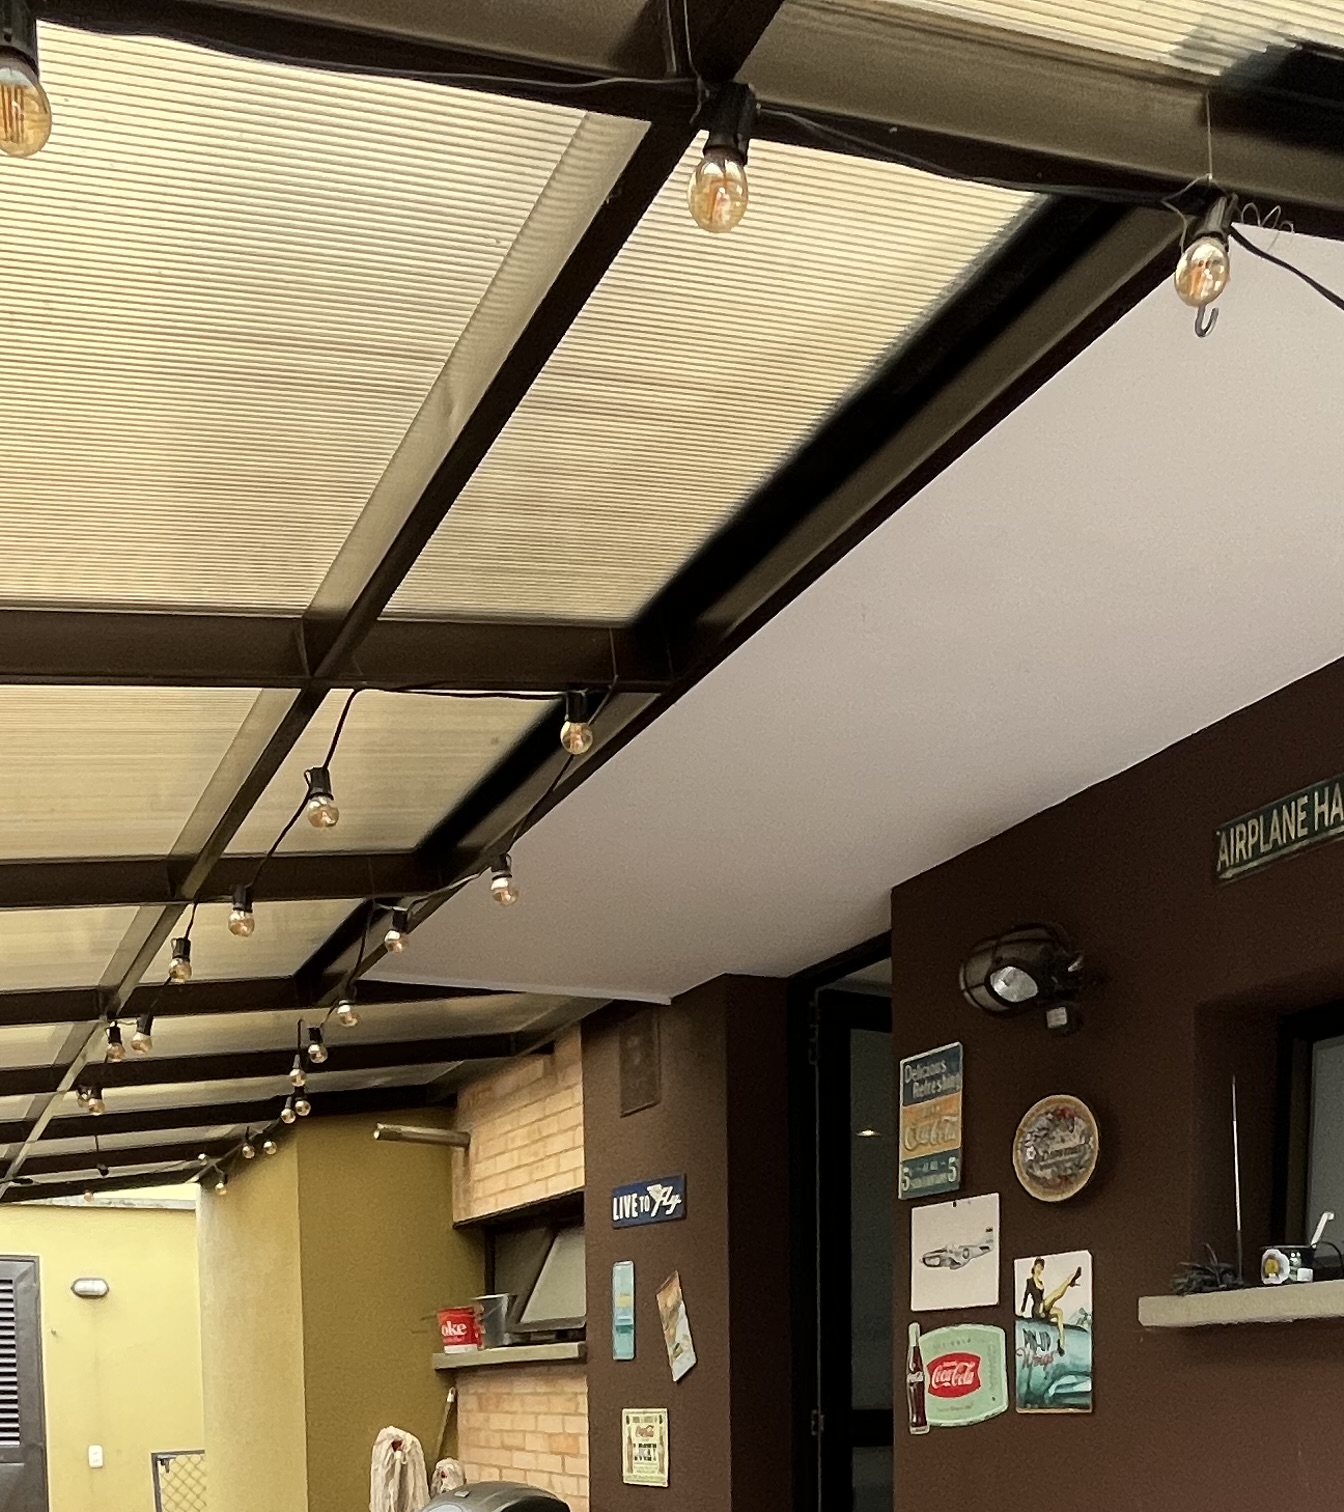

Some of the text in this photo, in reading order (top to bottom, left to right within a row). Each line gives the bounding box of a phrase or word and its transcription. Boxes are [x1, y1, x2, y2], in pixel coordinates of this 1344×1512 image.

[1216, 796, 1308, 871] AIRPLANE
[613, 1193, 638, 1221] LIVE
[639, 1195, 650, 1213] TO
[441, 1320, 467, 1337] oke
